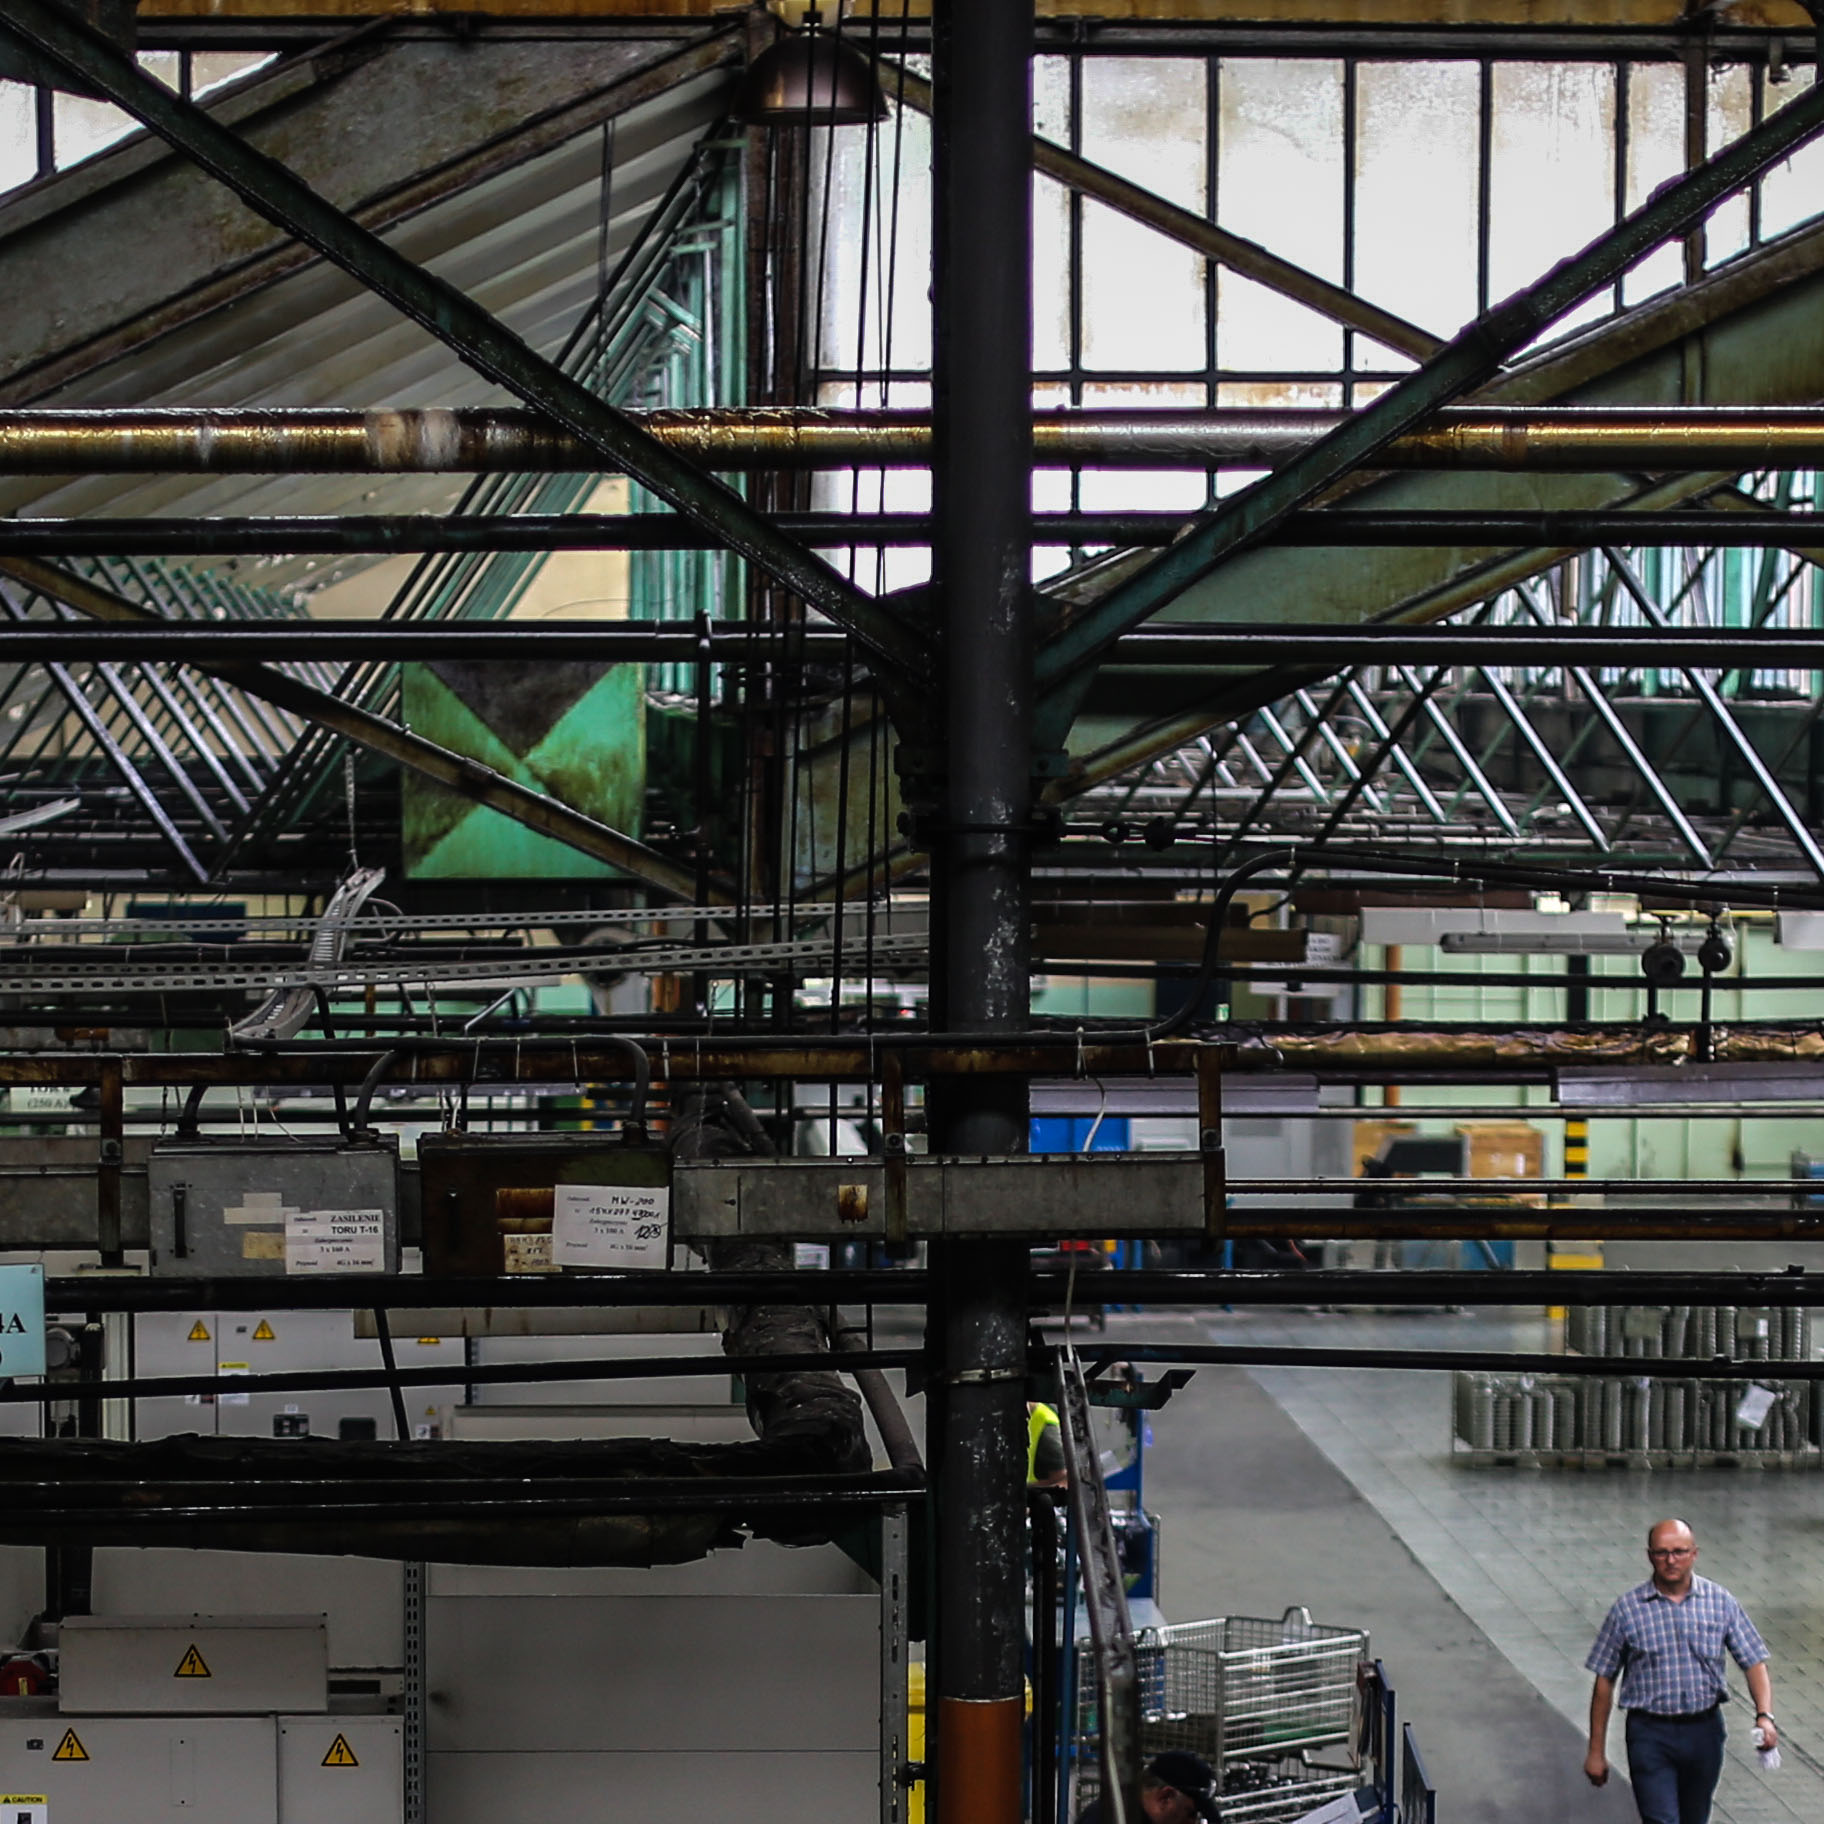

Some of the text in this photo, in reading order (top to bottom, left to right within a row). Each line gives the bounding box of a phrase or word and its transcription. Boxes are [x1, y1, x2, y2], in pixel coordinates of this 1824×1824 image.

[330, 1214, 379, 1223] ZASILENIE
[332, 1225, 379, 1234] TORU T-16
